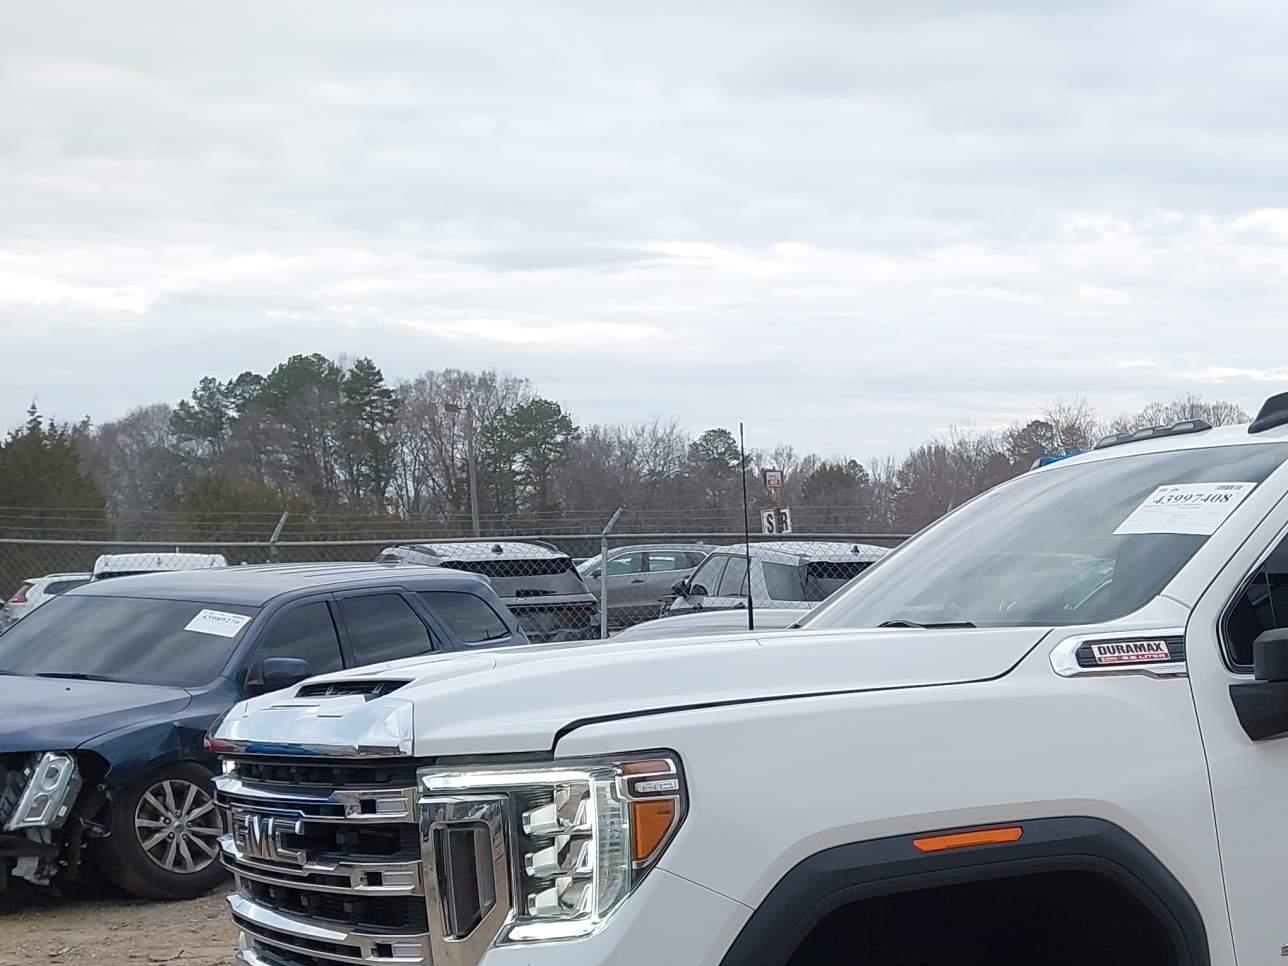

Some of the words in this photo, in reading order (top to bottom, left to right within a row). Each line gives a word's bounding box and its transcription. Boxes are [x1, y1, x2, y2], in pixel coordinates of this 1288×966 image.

[1153, 493, 1234, 505] 43997408
[1097, 642, 1165, 656] DURAMAX
[232, 812, 307, 865] GMC
